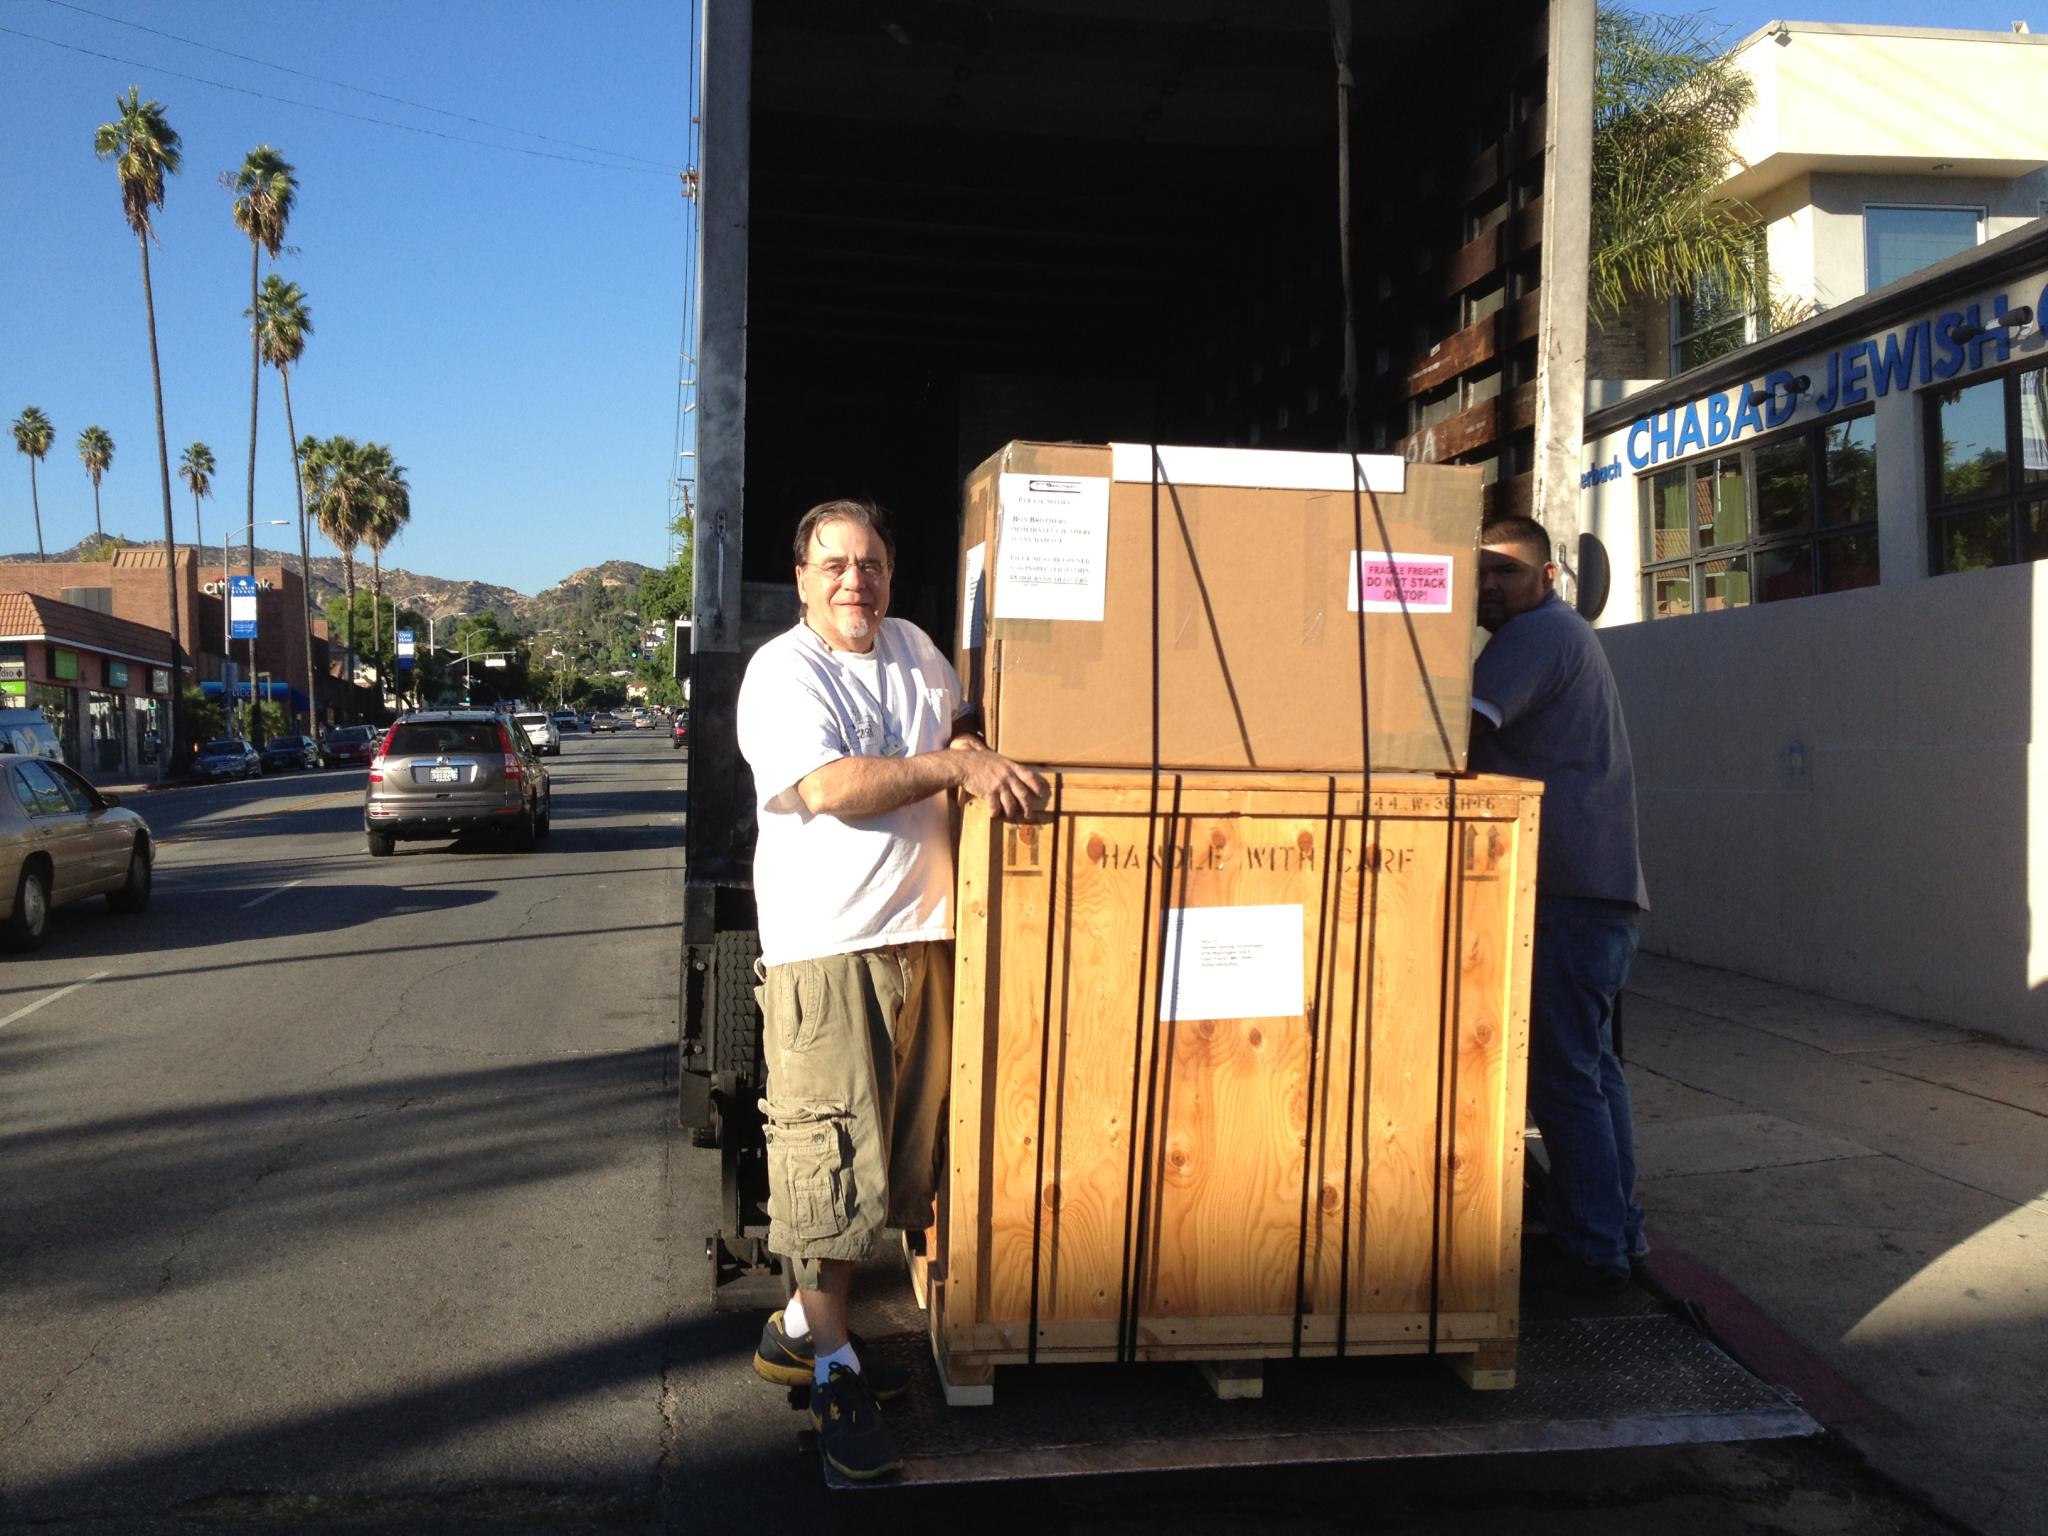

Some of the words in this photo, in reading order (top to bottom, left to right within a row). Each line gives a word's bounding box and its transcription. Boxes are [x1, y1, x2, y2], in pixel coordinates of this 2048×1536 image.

[1627, 370, 1797, 470] CHABAD
[1815, 294, 2010, 414] JEWISH
[1368, 566, 1405, 575] FRAGILE
[1407, 566, 1445, 576] FREIGHT
[1366, 576, 1382, 587] DO
[1385, 577, 1407, 588] NOT
[1410, 577, 1446, 588] STACK
[1403, 590, 1428, 601] TOP!
[1102, 844, 1225, 871] HANDLE
[1246, 845, 1315, 872] WITH
